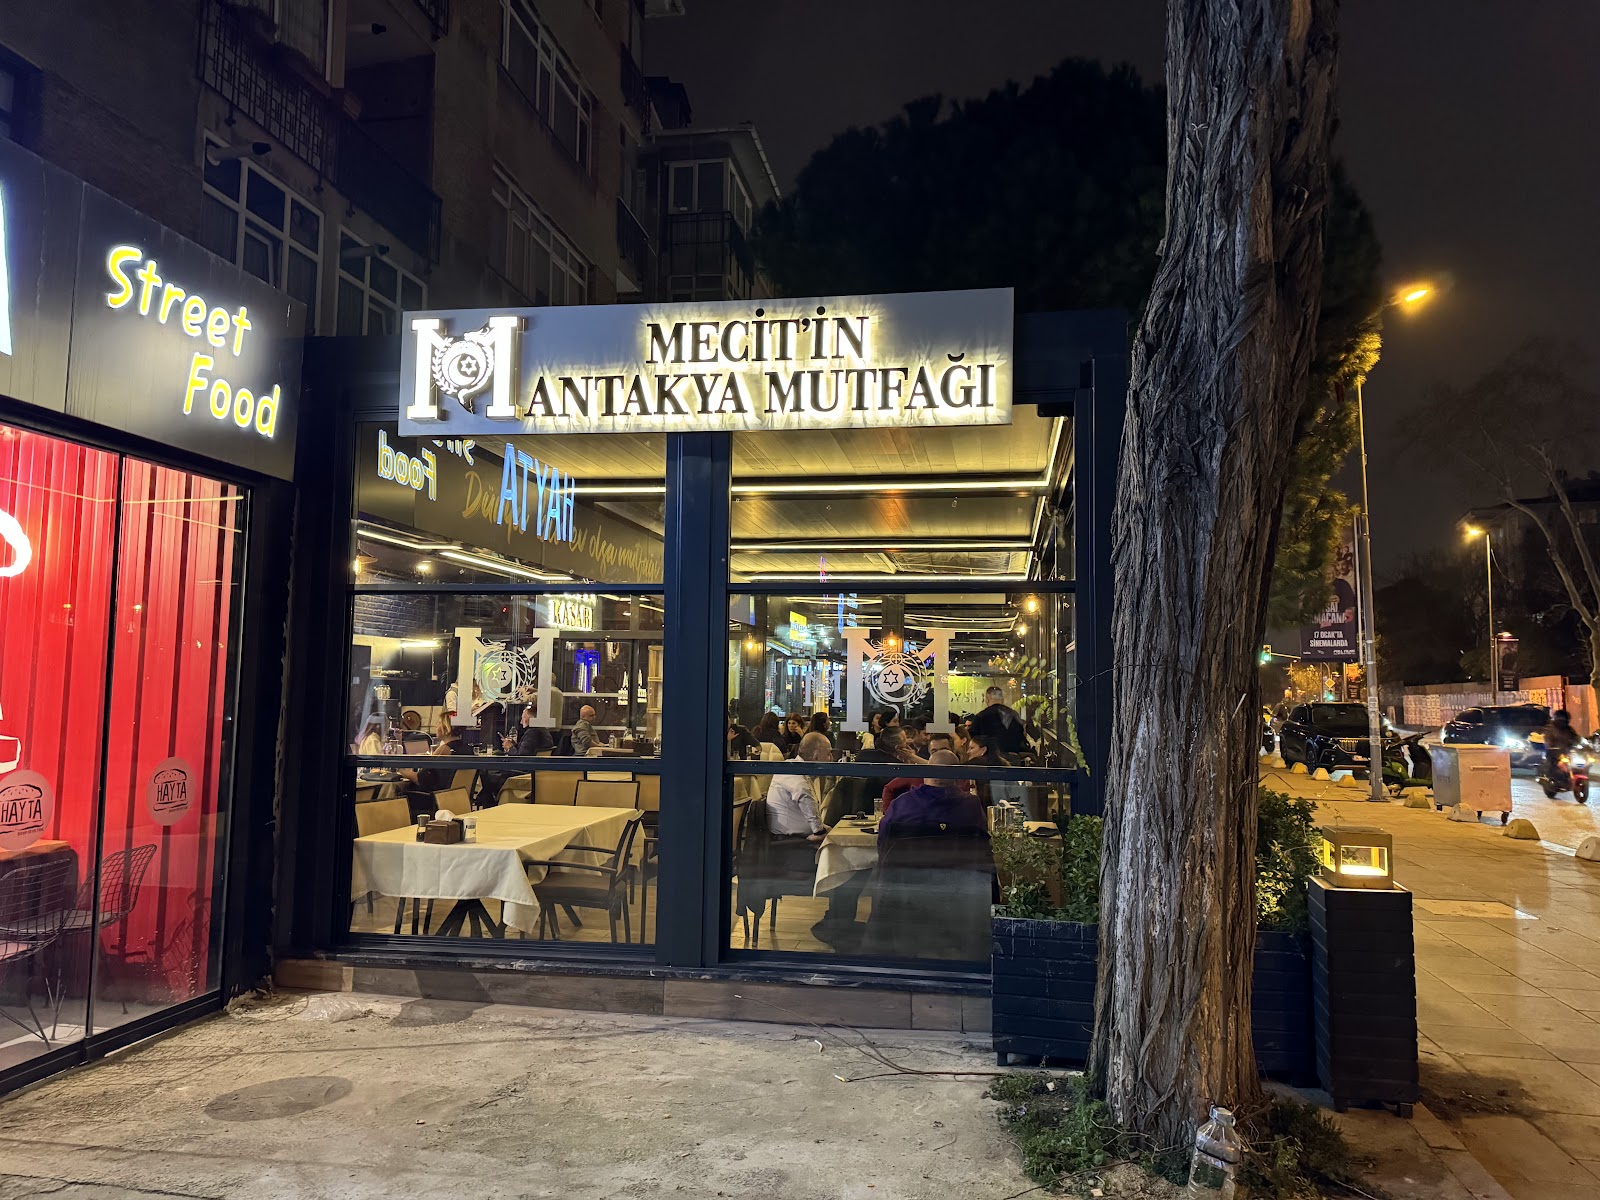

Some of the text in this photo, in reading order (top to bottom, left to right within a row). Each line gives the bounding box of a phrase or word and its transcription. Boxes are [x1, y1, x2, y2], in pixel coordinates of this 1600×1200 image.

[107, 246, 251, 356] Street
[645, 306, 869, 364] MECİT'İN
[183, 352, 280, 438] Food
[523, 352, 995, 417] ANTAKYA MUTFAĞI
[1, 799, 42, 823] HAYTA
[157, 781, 187, 802] HAYTA
